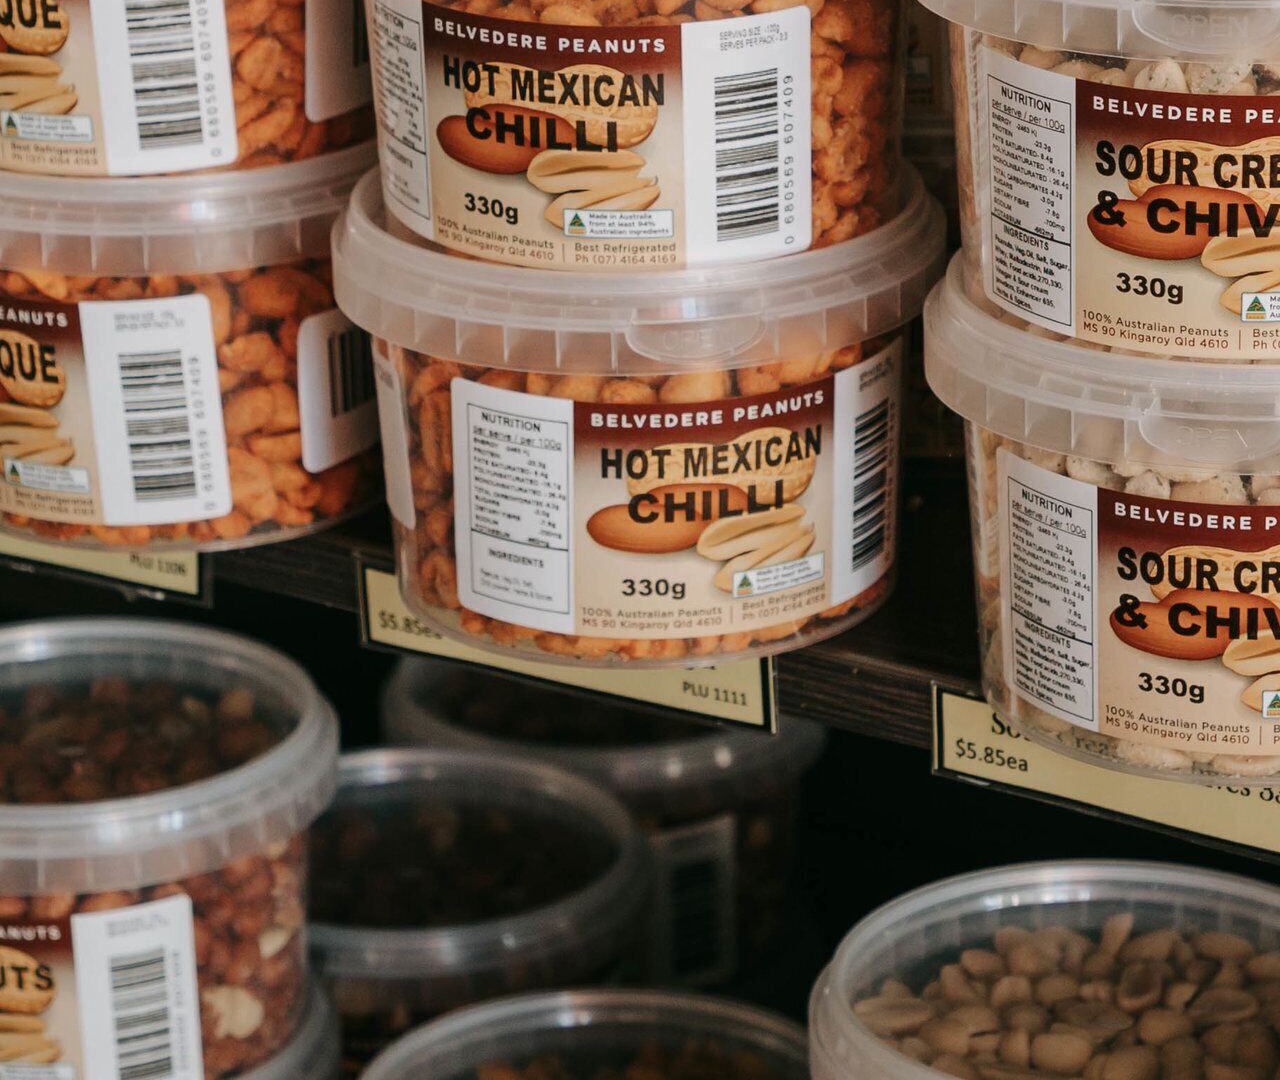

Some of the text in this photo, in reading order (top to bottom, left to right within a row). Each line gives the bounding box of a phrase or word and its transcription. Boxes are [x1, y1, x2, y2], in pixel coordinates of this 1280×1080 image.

[434, 18, 665, 54] BELVEDERE PEANUTS
[443, 55, 664, 106] HOT MEXICAN
[1093, 96, 1231, 123] BELVEDERE
[466, 108, 619, 153] CHILLI
[1096, 140, 1198, 186] SOUR
[464, 193, 519, 225] 330g
[1093, 190, 1127, 227] &
[1116, 272, 1184, 304] 330g
[481, 411, 541, 433] NUTRITION
[591, 390, 824, 428] BELVEDERE PEANUTS
[601, 425, 821, 479] HOT MEXICAN
[628, 479, 784, 524] CHILLI
[1115, 502, 1251, 530] BELVEDERE
[1117, 547, 1218, 591] SOUR
[621, 579, 686, 599] 330g
[1115, 594, 1149, 629] &
[682, 681, 748, 706] PLU 1111
[1139, 672, 1205, 704] 330g
[955, 738, 1028, 771] $5.85ea
